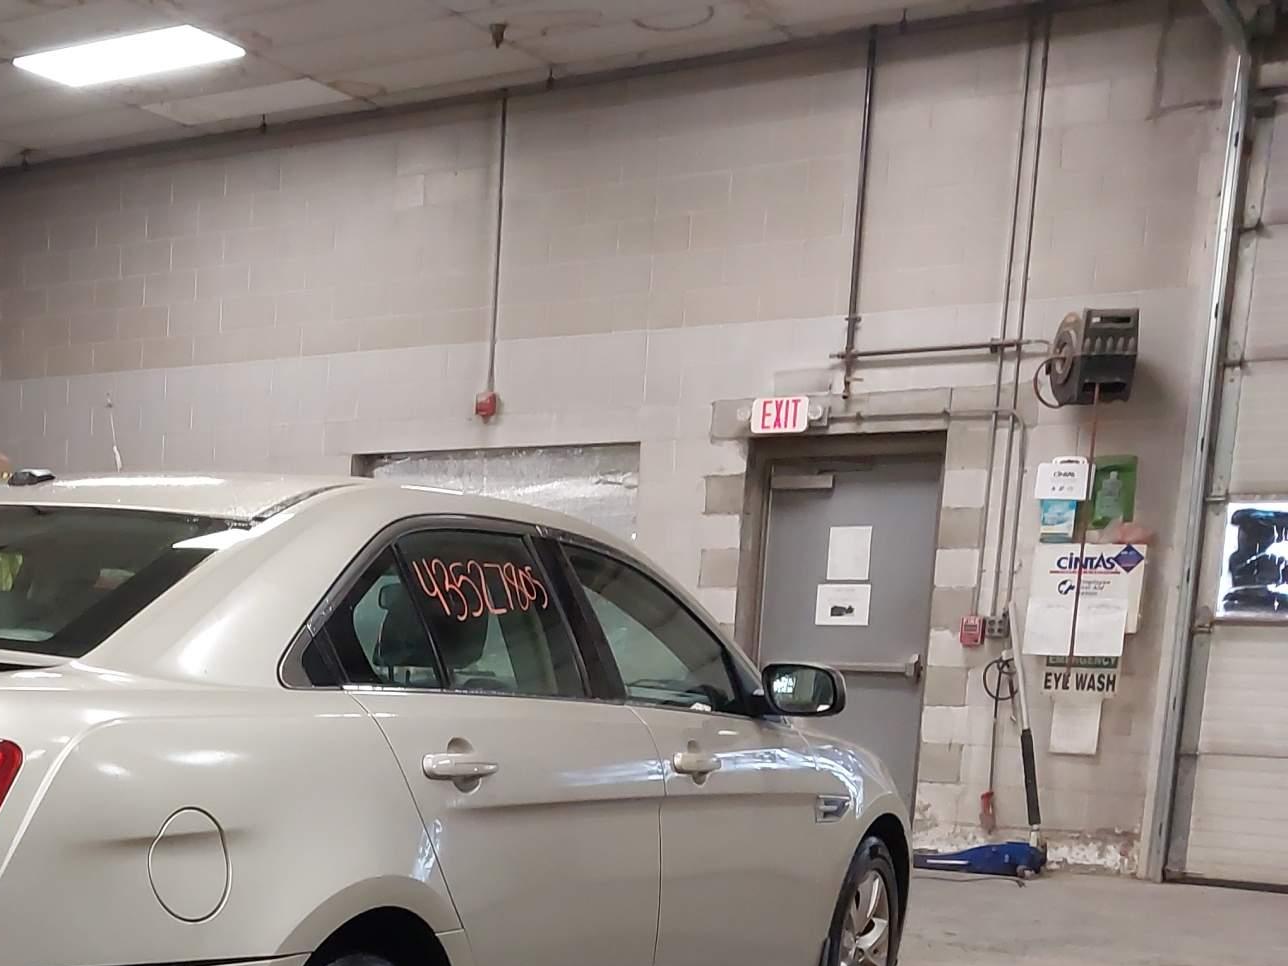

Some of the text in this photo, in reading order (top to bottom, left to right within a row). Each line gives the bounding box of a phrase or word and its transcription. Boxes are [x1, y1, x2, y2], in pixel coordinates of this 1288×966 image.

[760, 399, 801, 430] EXIT
[1056, 552, 1116, 570] CINTAS
[412, 557, 549, 621] 43527805
[1043, 672, 1116, 692] EYE WASH
